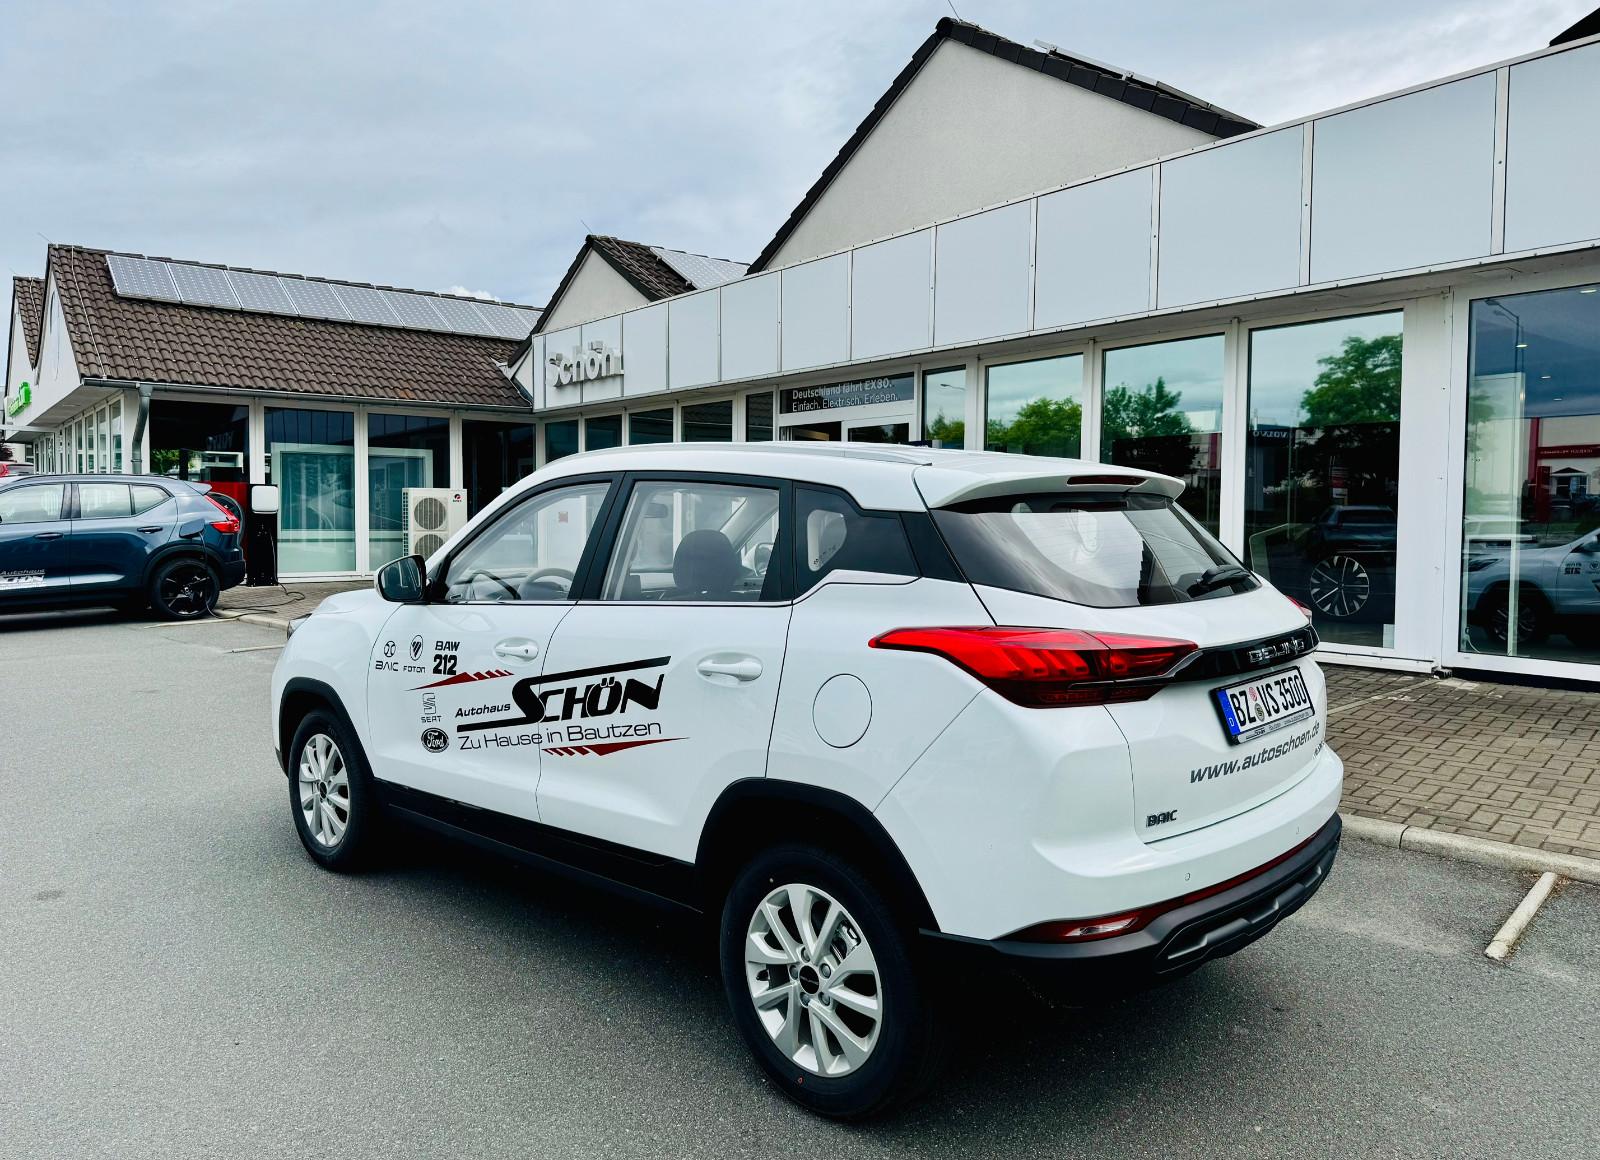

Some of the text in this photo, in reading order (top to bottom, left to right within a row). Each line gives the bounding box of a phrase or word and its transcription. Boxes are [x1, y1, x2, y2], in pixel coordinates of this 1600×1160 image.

[545, 341, 622, 387] Schön
[792, 384, 841, 400] Deutschland
[842, 382, 863, 394] fährt
[792, 392, 898, 412] Einfach. Elektrisch. Erleben.
[435, 641, 460, 651] BAW
[375, 660, 398, 671] BAIC
[433, 654, 457, 675] 212
[455, 702, 511, 718] Autohaus
[1230, 690, 1257, 727] BZ
[1256, 682, 1280, 718] VS
[421, 715, 442, 723] SEAT
[426, 731, 445, 748] Ford
[457, 722, 662, 751] Zu Hause in Bautzen
[1190, 721, 1320, 784] www.autoschoen.de
